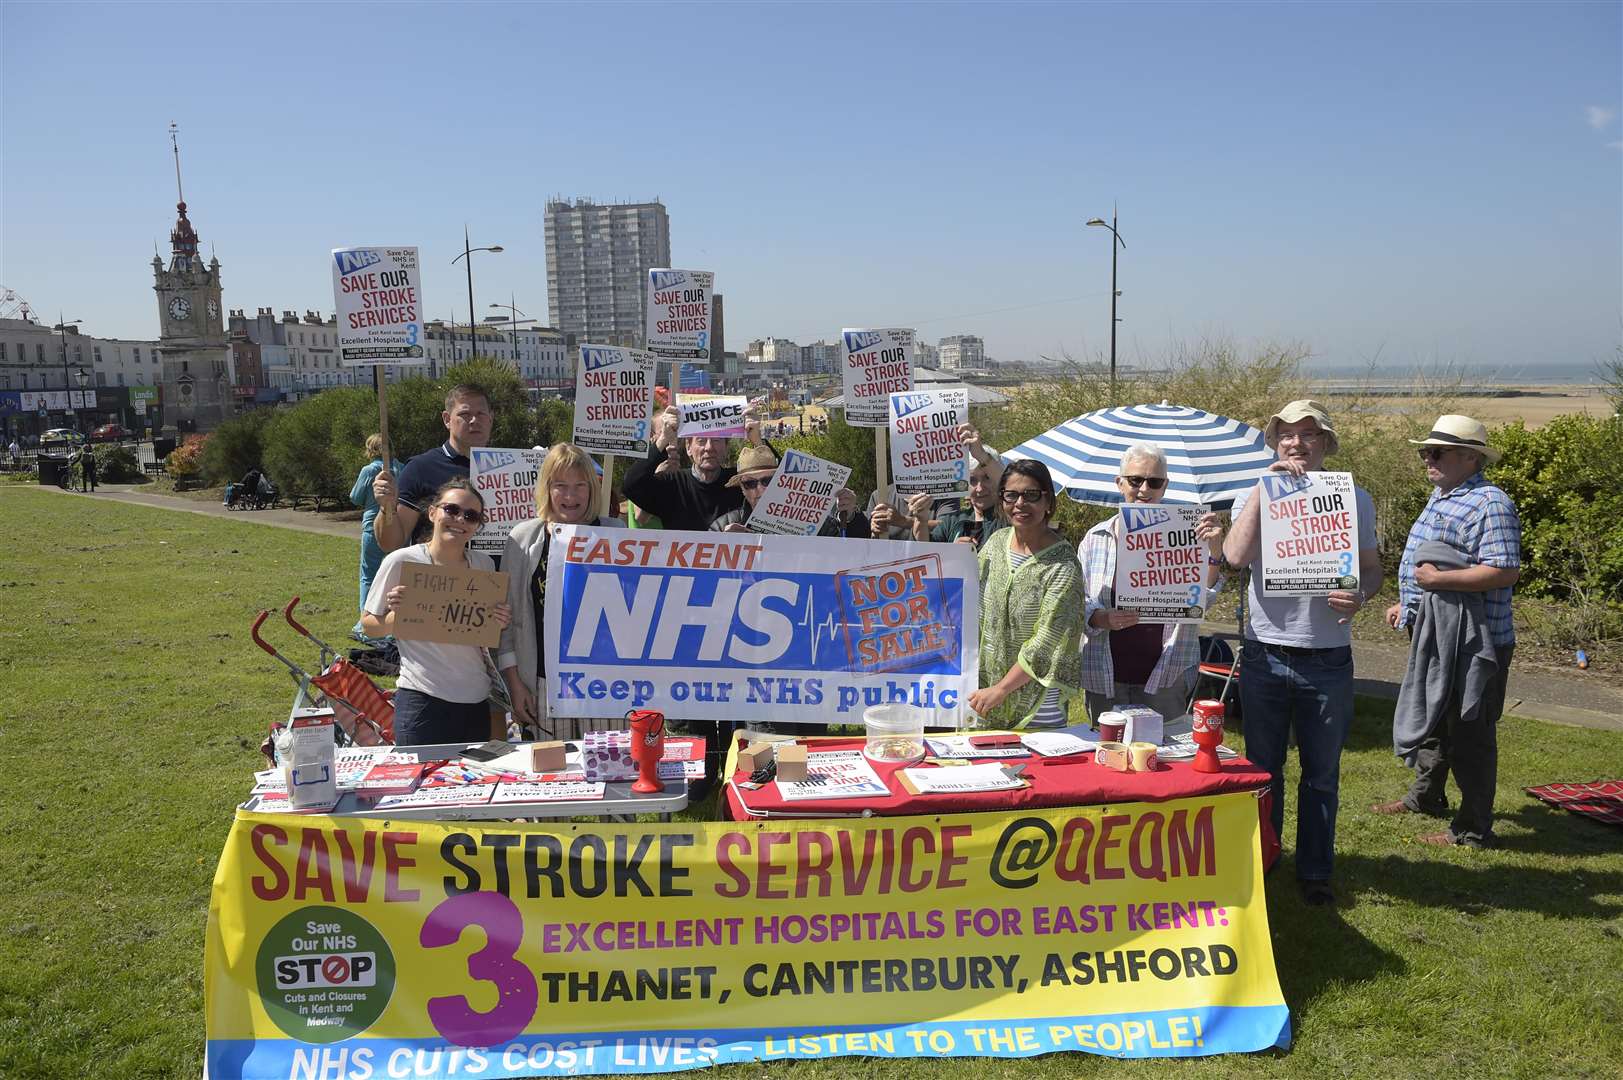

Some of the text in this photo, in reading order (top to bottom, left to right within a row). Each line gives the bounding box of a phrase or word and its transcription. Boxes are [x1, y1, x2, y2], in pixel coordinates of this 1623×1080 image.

[341, 250, 380, 273] NHS
[340, 270, 410, 293] SAVE OUR
[656, 272, 684, 290] NHS
[362, 288, 416, 308] STROKE
[654, 288, 704, 305] SAVE OUR
[348, 306, 416, 329] SERVICES
[668, 303, 708, 318] STROKE
[374, 336, 406, 344] Hospitals
[406, 324, 418, 346] 3
[656, 318, 706, 334] SERVICES
[697, 332, 706, 348] 3
[588, 350, 622, 368] NHS
[848, 348, 905, 368] SAVE OUR
[584, 372, 616, 388] SAVE
[620, 370, 645, 386] OUR
[864, 362, 910, 382] STROKE
[601, 388, 648, 404] STROKE
[854, 378, 909, 398] SERVICES
[586, 404, 646, 420] SERVICES
[684, 404, 742, 424] JUSTICE
[692, 400, 714, 408] want
[898, 394, 932, 414] NHS
[576, 420, 646, 440] Excellent Hospitals 3
[896, 415, 929, 434] SAVE
[932, 410, 958, 428] OUR
[479, 452, 515, 472] NHS
[788, 454, 820, 473] NHS
[902, 444, 964, 468] SERVICES
[954, 461, 964, 480] 3
[477, 473, 510, 490] SAVE
[777, 474, 834, 496] SAVE OUR
[494, 488, 536, 505] STROK
[786, 492, 831, 511] STROKE
[482, 504, 536, 523] SERVICE
[766, 502, 822, 524] SERVICES
[1269, 494, 1344, 520] SAVE OUR
[752, 516, 775, 529] Excellent
[1129, 508, 1169, 531] NHS
[1290, 512, 1352, 536] STROKE
[1126, 530, 1198, 551] SAVE OUR
[1276, 532, 1351, 558] SERVICES
[566, 537, 763, 570] EAST KENT
[1146, 547, 1204, 568] STROKE
[1266, 552, 1352, 576] Excellent Hospitals 3
[413, 573, 480, 596] FIGHT 4
[849, 565, 927, 606] NOT
[1130, 566, 1200, 588] SERVICES
[1118, 586, 1200, 606] Excellent Hospitals 3
[416, 603, 486, 628] THE NHS
[566, 572, 800, 664] NHS
[858, 598, 932, 634] FOR
[857, 622, 946, 668] SALE
[558, 672, 958, 712] Keep our NHS public
[830, 775, 872, 786] SAVE
[251, 804, 1218, 903] SAVE STROKE SERVICE @QEQM
[307, 922, 341, 934] Save
[543, 899, 1230, 954] EXCELLENT HOSPITALS FOR EAST KENT:
[292, 936, 356, 952] Our NHS
[277, 956, 372, 984] STOP
[420, 890, 539, 1048] 3
[542, 944, 1239, 1004] THANET, CANTERBURY, ASHFORD
[284, 992, 366, 1003] Cuts and Closures
[300, 1003, 353, 1014] in Kent and
[307, 1016, 346, 1026] Medway
[290, 1015, 1204, 1080] NHS CUTS COST LIVES LISTEN TO THE PEOPLE!
